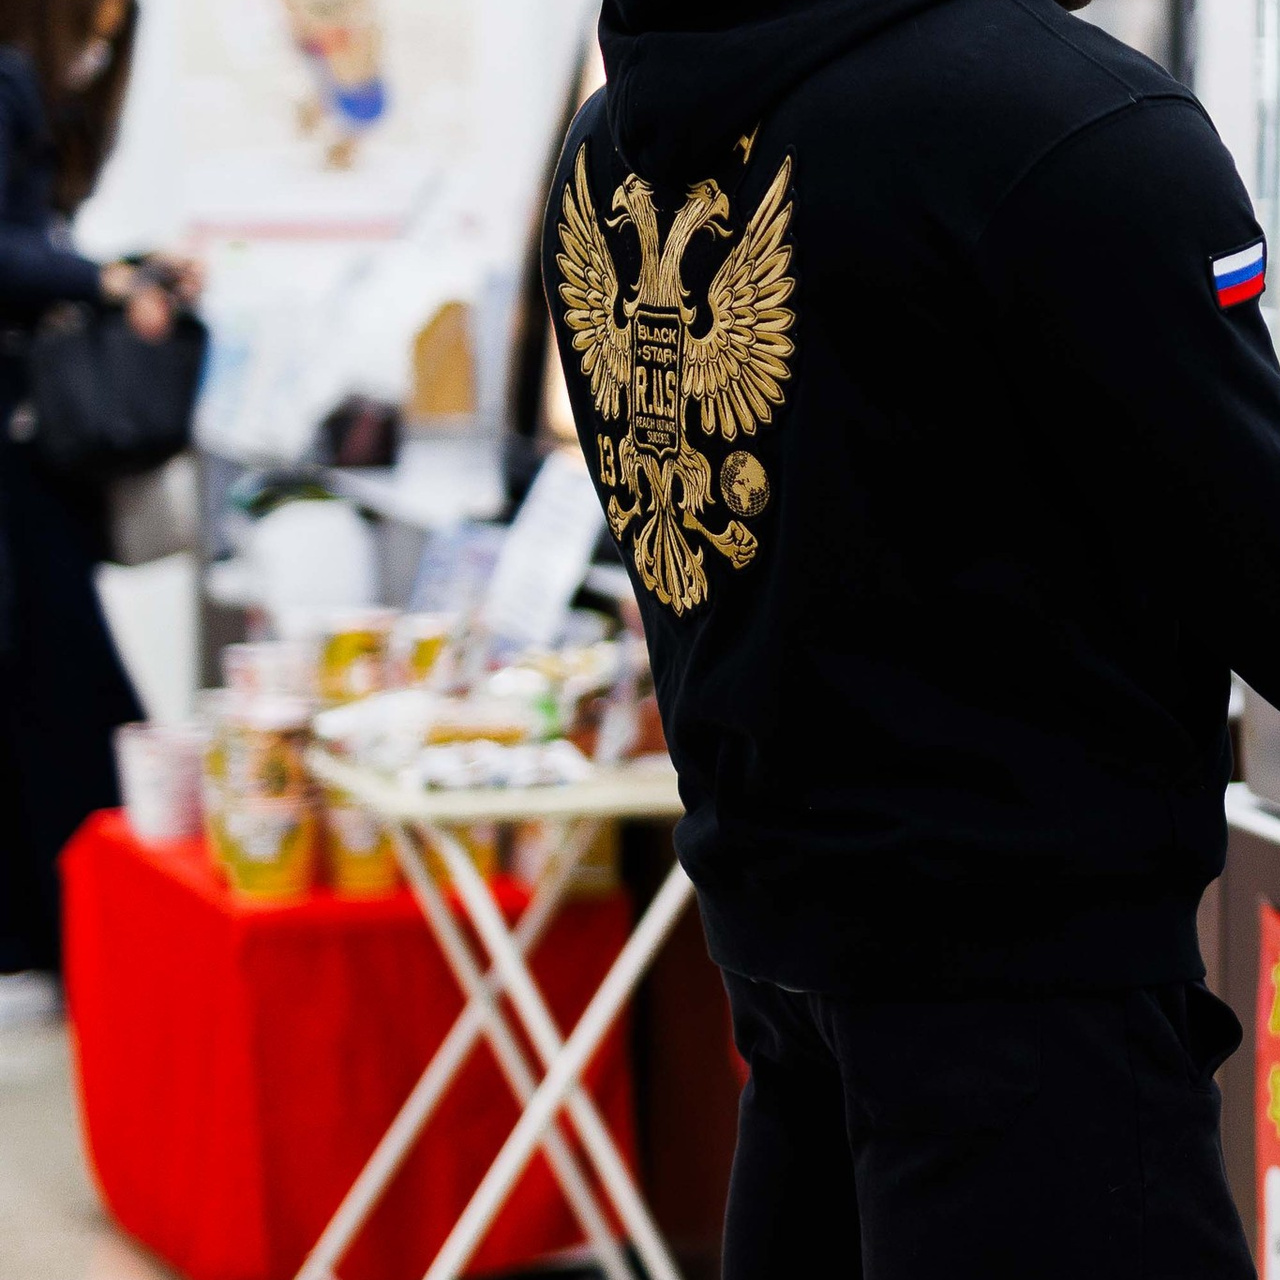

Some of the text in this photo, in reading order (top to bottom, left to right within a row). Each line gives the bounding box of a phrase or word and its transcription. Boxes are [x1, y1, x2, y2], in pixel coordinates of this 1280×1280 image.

[638, 326, 677, 345] BLACK
[642, 346, 673, 364] STAR
[636, 417, 655, 430] REACH
